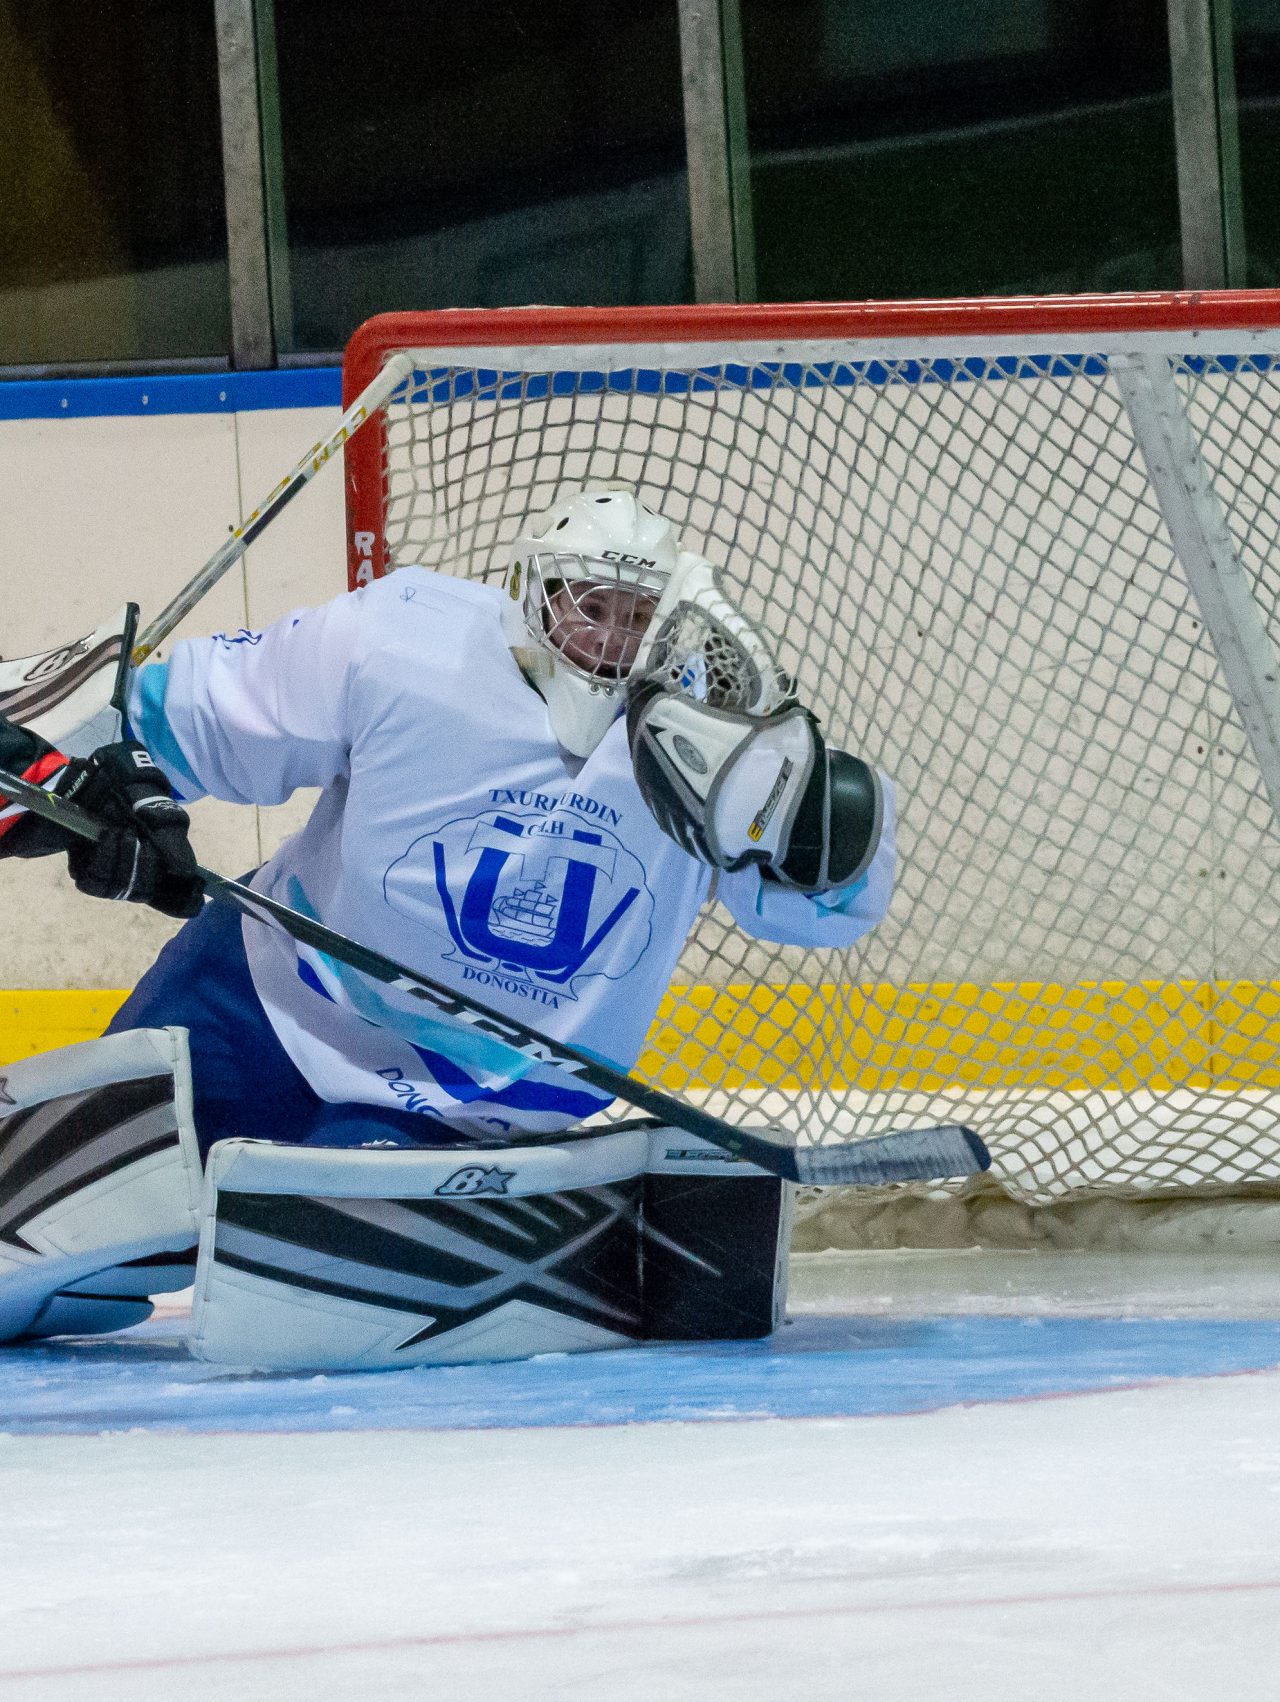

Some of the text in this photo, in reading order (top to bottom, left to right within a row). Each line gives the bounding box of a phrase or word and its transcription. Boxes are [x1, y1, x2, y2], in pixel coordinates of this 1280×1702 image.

[600, 550, 657, 569] CCM
[462, 965, 560, 1010] DONOSTIA
[390, 972, 588, 1077] CCM
